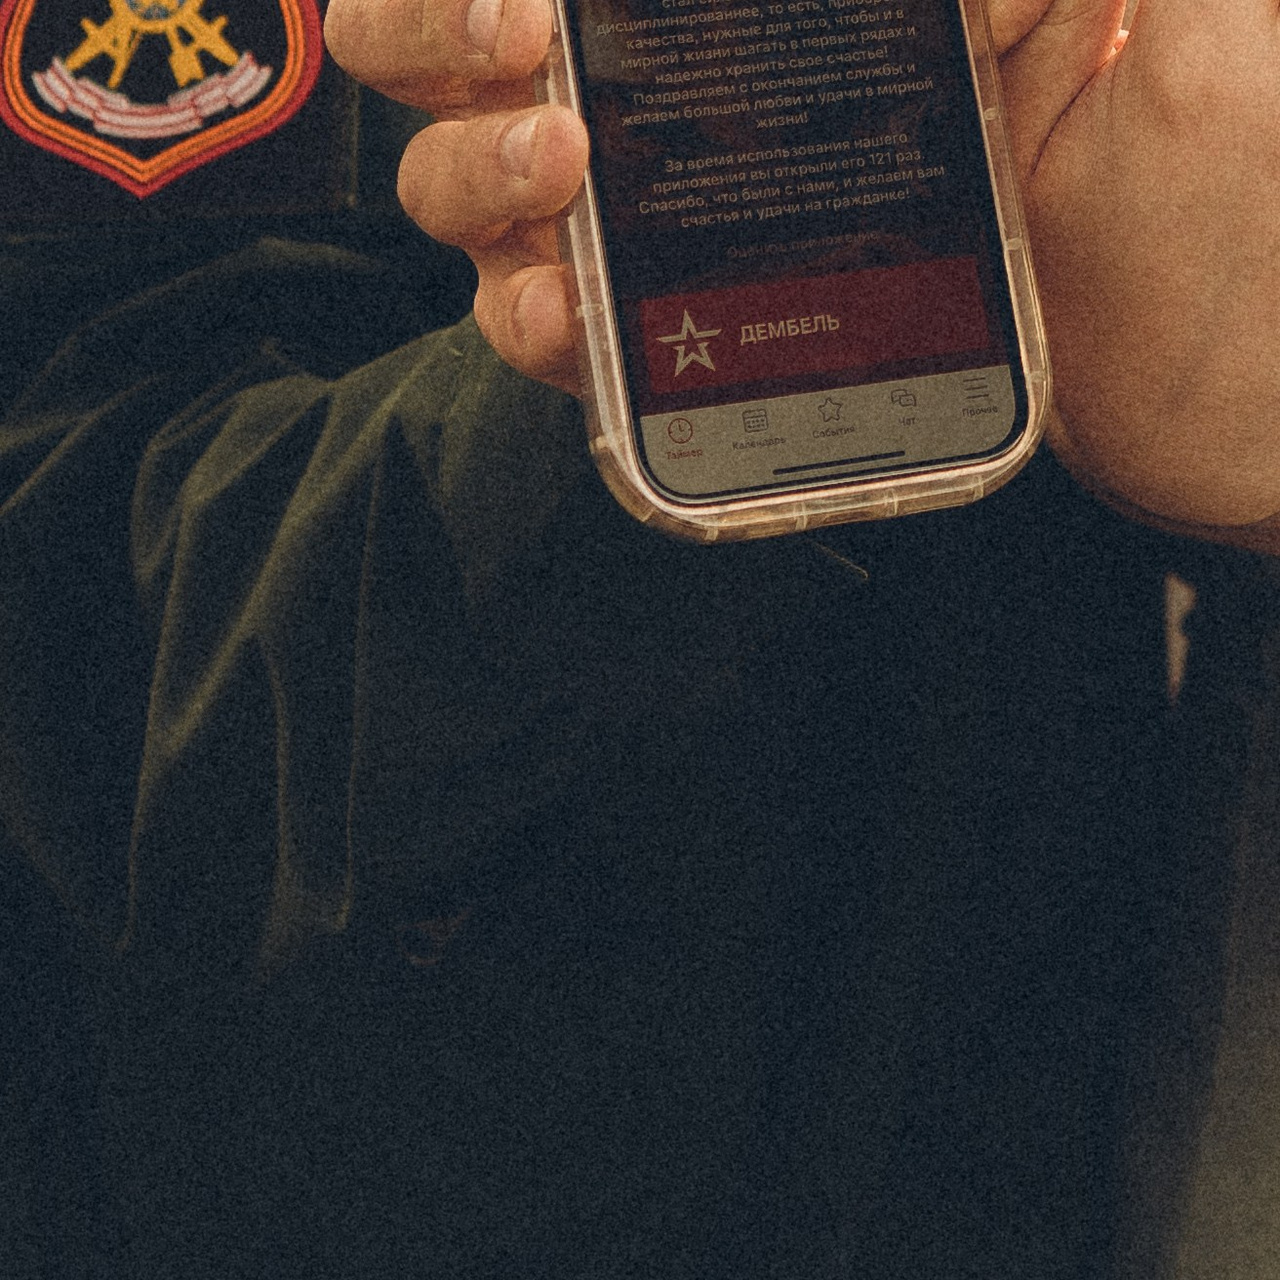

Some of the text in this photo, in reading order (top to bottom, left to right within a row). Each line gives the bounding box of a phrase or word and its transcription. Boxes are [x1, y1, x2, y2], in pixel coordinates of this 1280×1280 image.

[704, 26, 761, 43] нужные
[766, 23, 791, 36] для
[836, 11, 880, 26] чтобы
[883, 10, 893, 20] и
[896, 9, 904, 19] в
[769, 5, 783, 14] то
[622, 26, 916, 70] мирной жизни шагать в первых рядах и
[634, 63, 916, 105] Поздравляем с окончанием службы и
[656, 69, 721, 84] надежно
[727, 61, 785, 77] хранить
[790, 57, 822, 68] свое
[622, 78, 933, 126] желаем большой любви и удачи в мирной
[665, 134, 908, 172] За время использования нашего
[654, 173, 747, 195] приложения
[751, 170, 771, 181] вы
[775, 162, 838, 178] открыли
[842, 158, 866, 169] его
[870, 152, 892, 166] 121
[714, 193, 738, 204] что
[742, 187, 781, 201] были
[785, 185, 793, 195] с
[843, 177, 852, 188] и
[856, 171, 913, 186] желаем
[918, 167, 945, 179] вам
[682, 212, 740, 228] счастья
[744, 209, 753, 220] и
[757, 204, 801, 221] удачи
[806, 202, 822, 212] на
[739, 314, 841, 346] ДЕМБЕЛЬ
